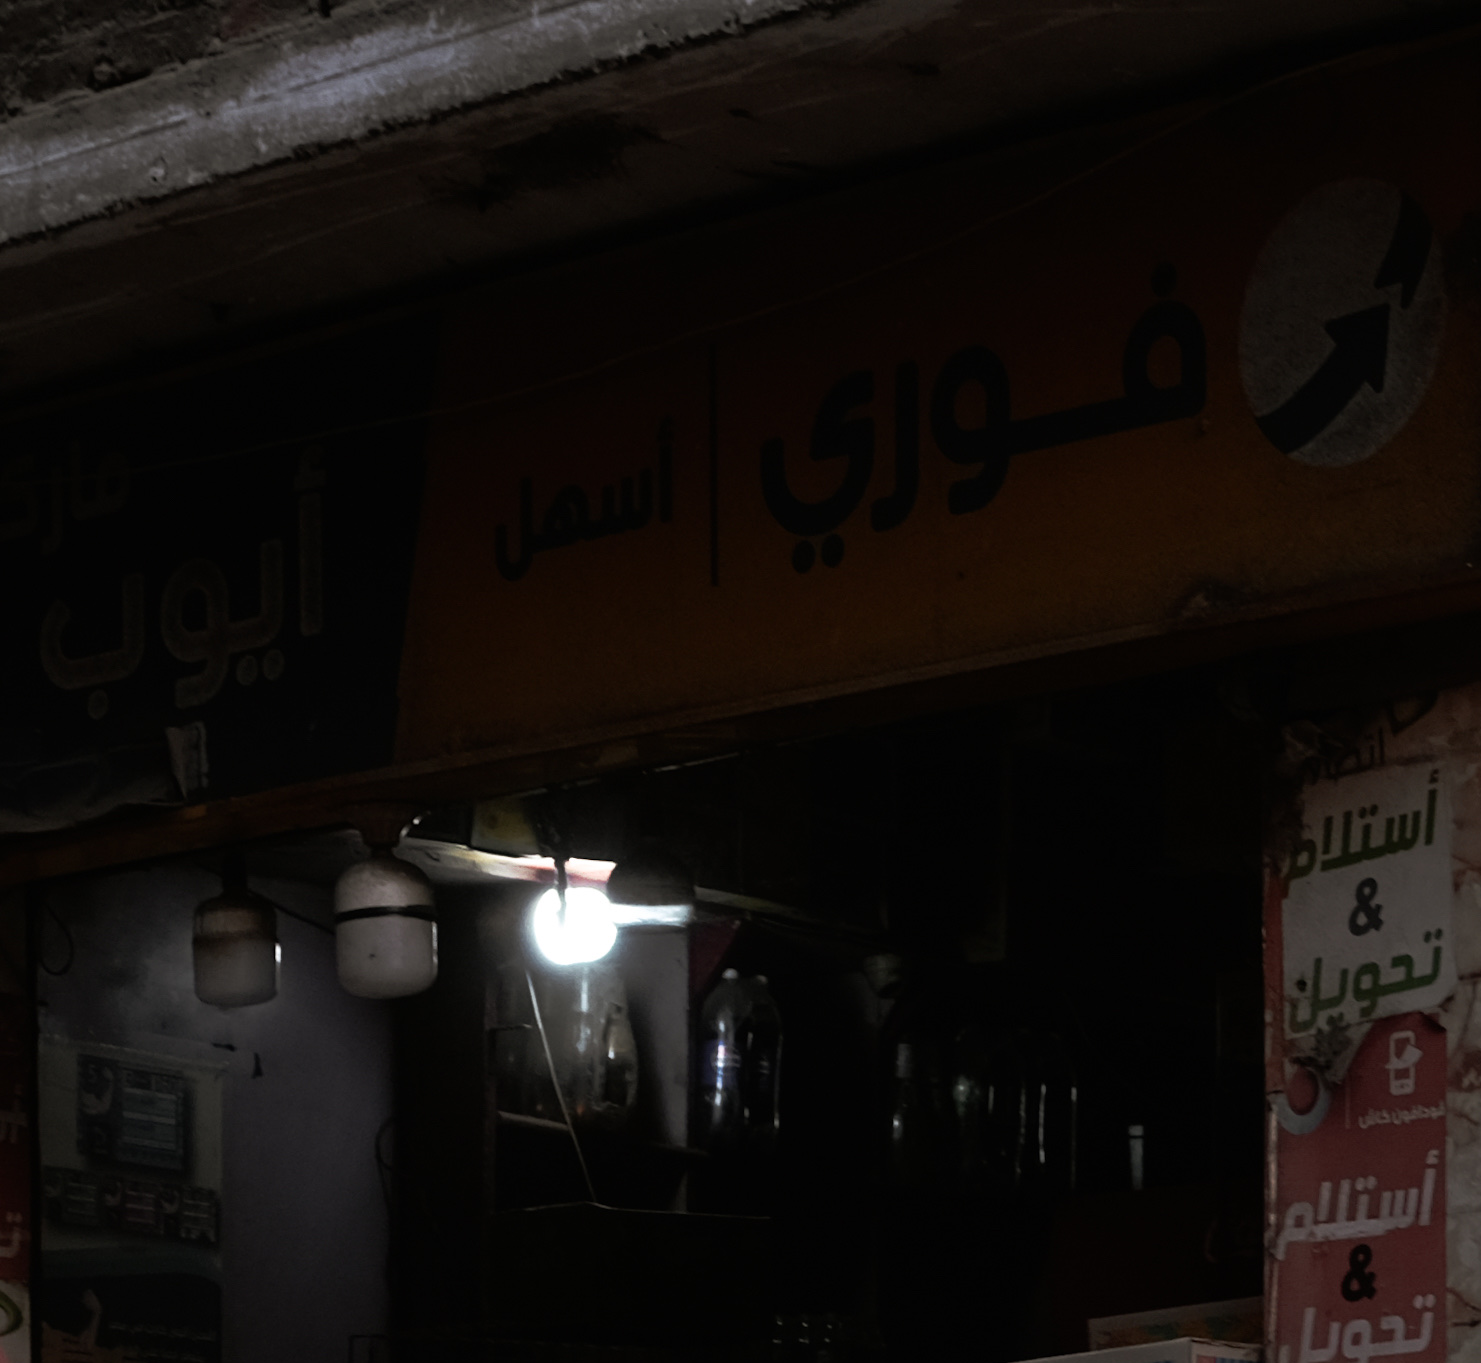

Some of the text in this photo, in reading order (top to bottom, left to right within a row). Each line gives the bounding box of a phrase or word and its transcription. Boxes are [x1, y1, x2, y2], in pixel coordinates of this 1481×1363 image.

[761, 261, 1208, 576] فوري
[494, 417, 673, 582] أسهل
[40, 444, 326, 720] أيوب
[1282, 769, 1441, 898] أستلام
[1348, 877, 1384, 936] &
[1286, 930, 1444, 1035] تحويل
[1277, 1149, 1440, 1259] أستلام
[1341, 1243, 1378, 1302] &
